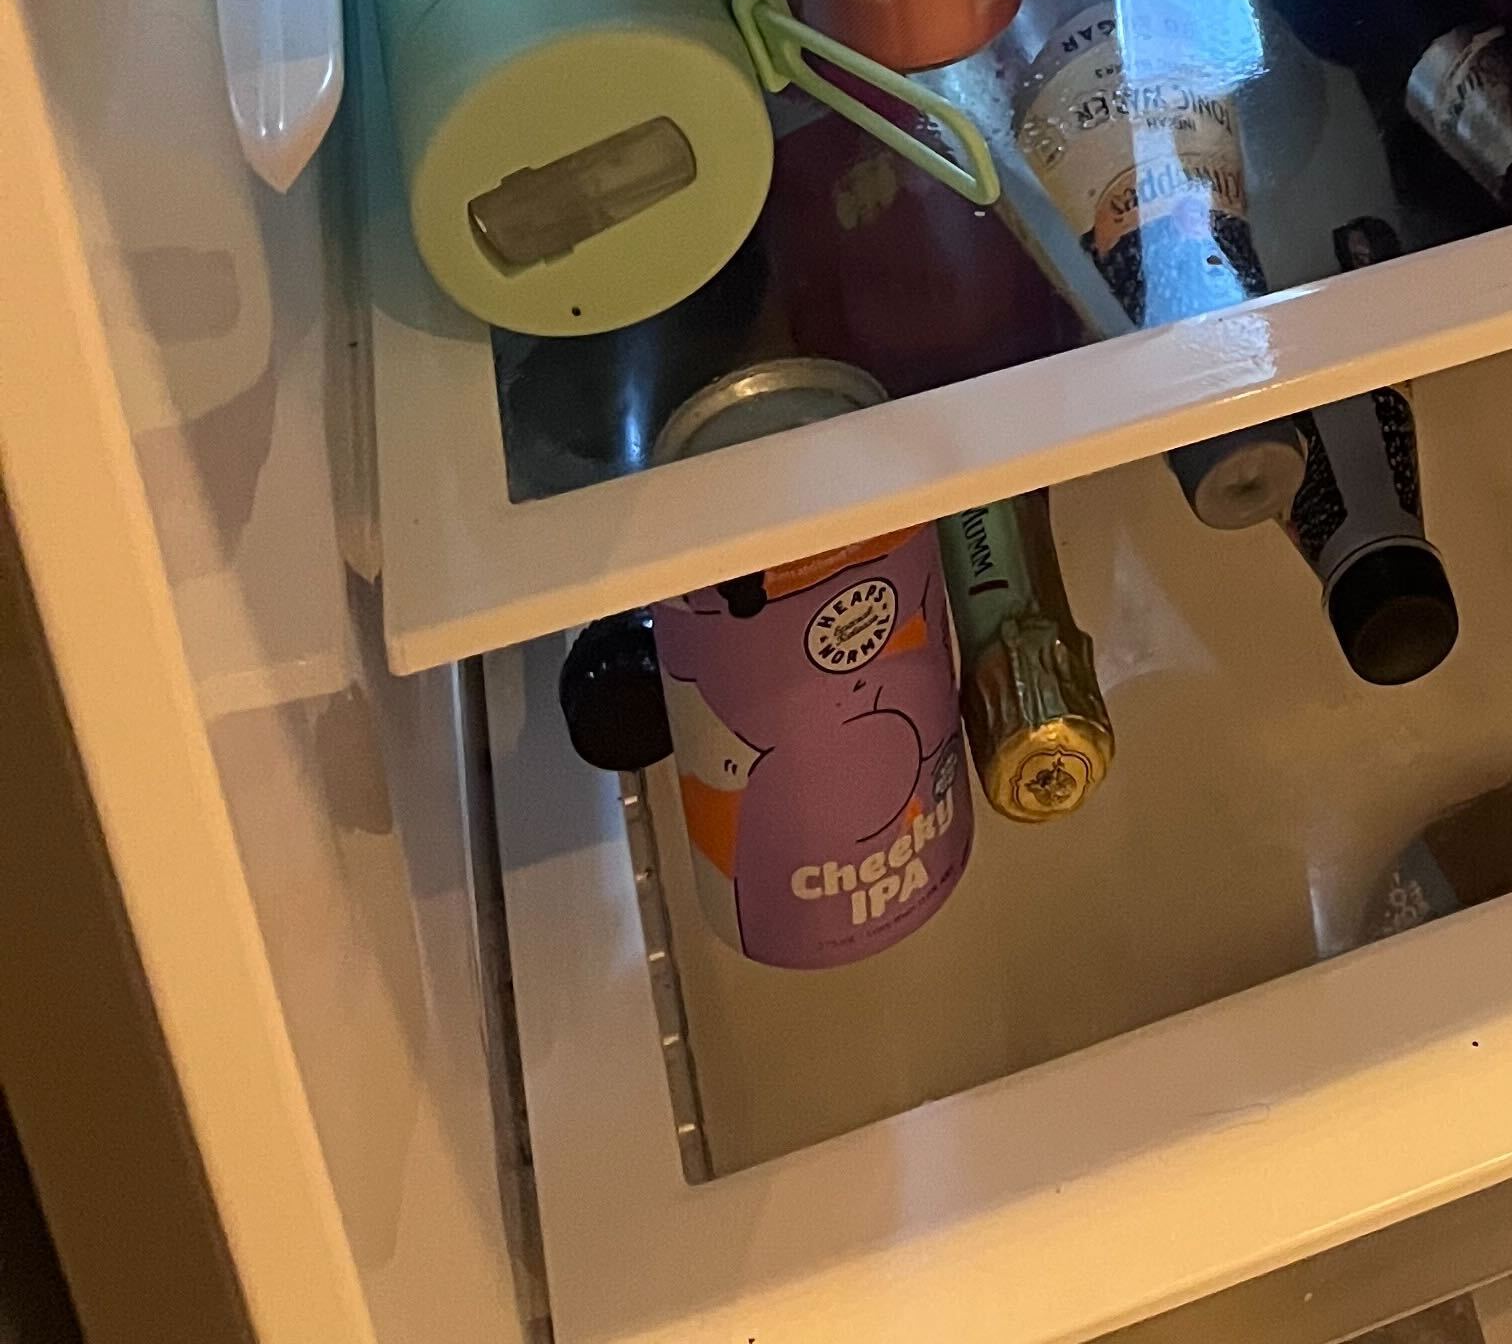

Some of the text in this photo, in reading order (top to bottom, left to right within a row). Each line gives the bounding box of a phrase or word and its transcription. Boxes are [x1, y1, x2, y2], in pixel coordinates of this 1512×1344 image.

[817, 583, 888, 630] HEAPS
[818, 614, 891, 666] NORMAL
[790, 786, 954, 901] Cheeky
[850, 857, 930, 926] IPA
